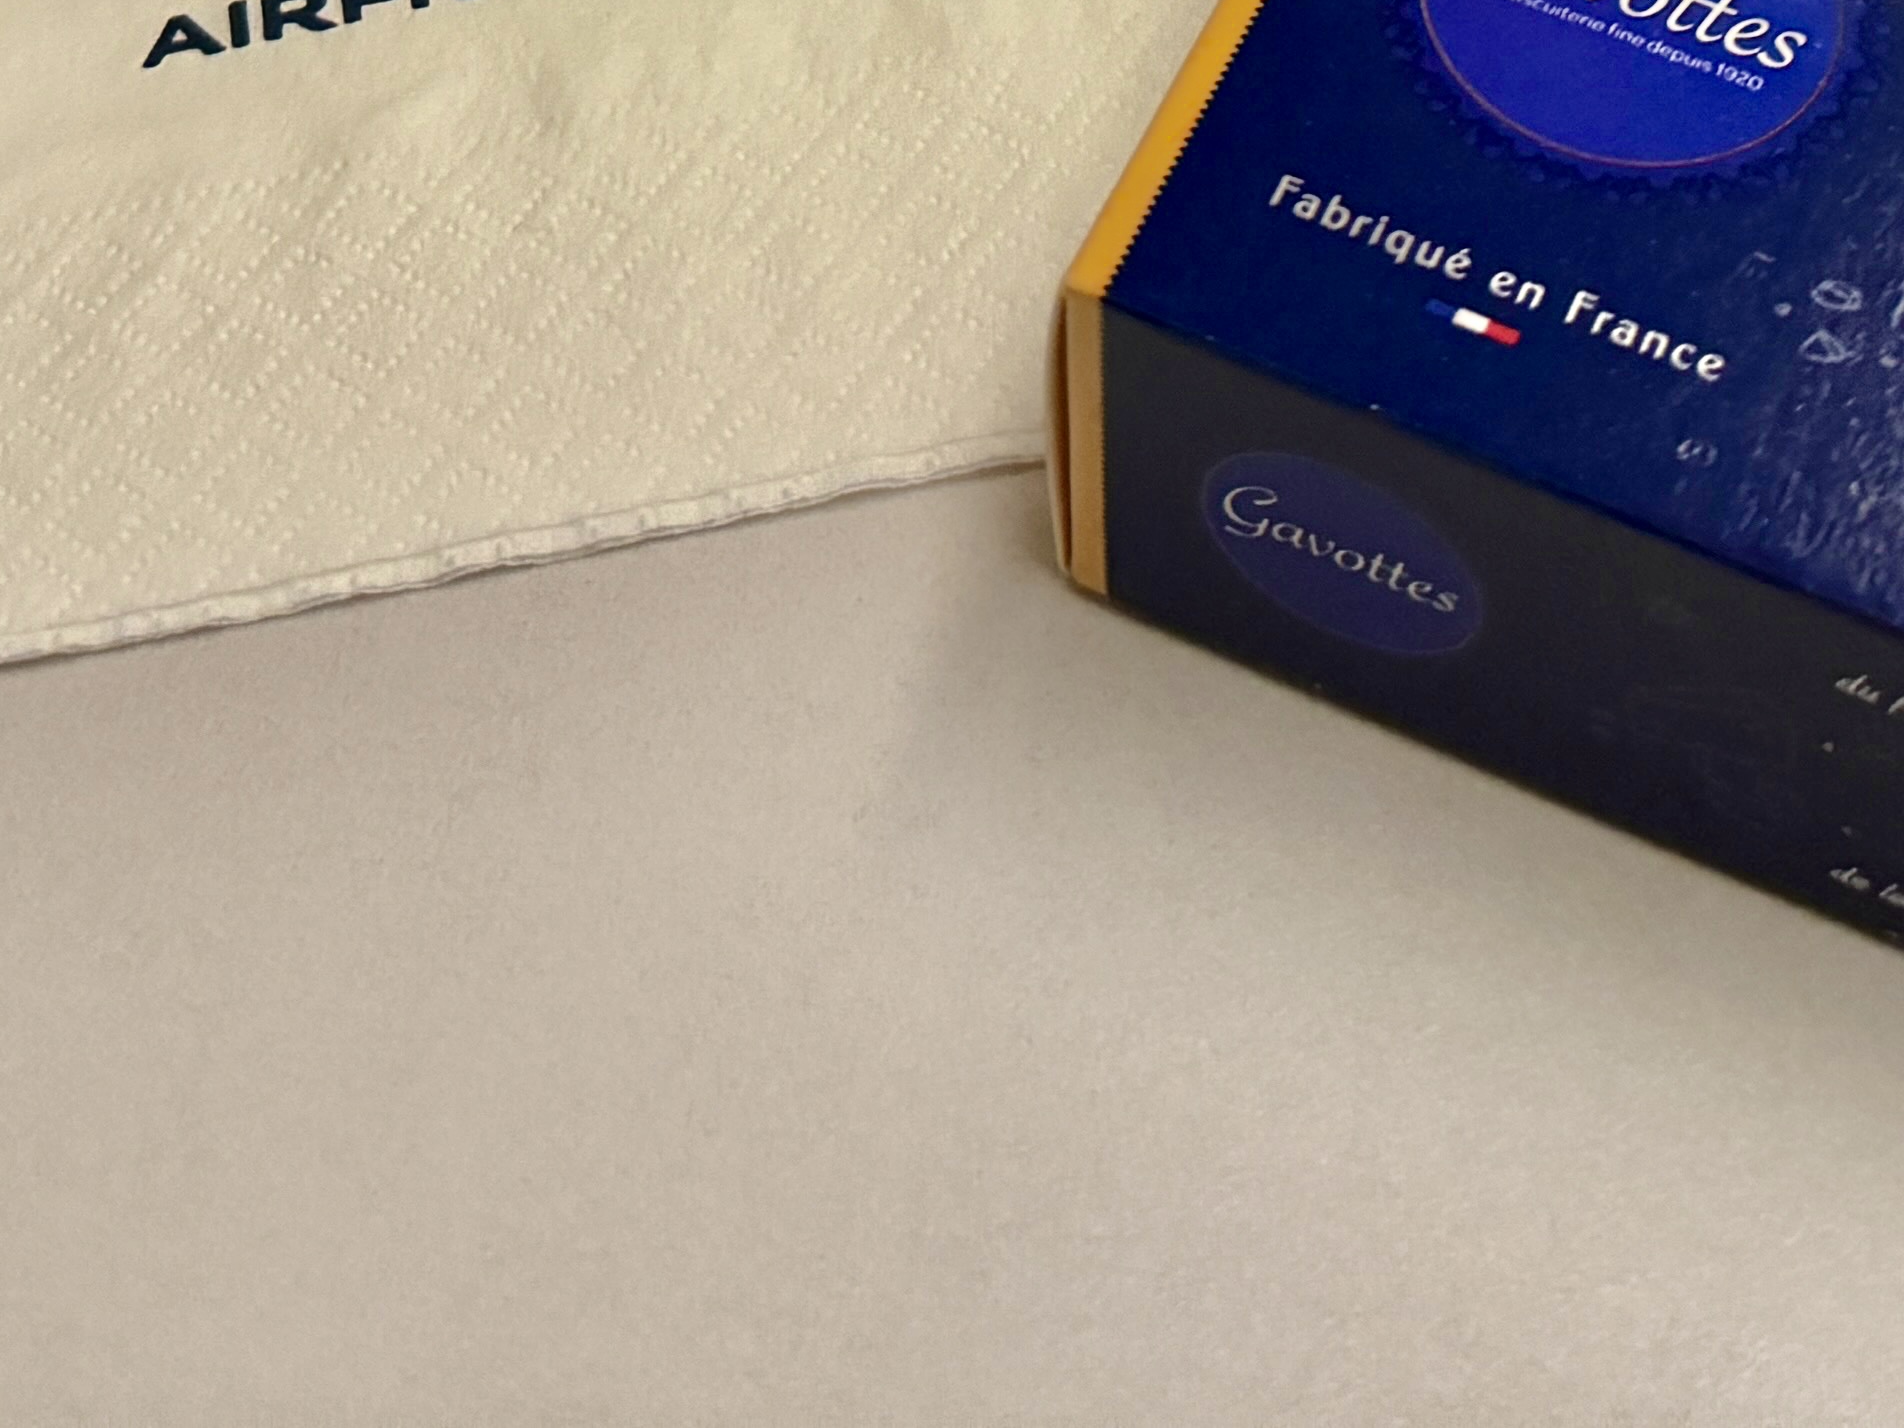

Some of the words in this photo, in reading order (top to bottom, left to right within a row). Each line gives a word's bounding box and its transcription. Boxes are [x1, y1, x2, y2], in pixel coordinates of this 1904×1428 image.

[1606, 22, 1646, 49] fine
[1646, 39, 1713, 75] depuis
[1715, 61, 1766, 92] 1920
[1268, 172, 1474, 281] Fabriqué
[1487, 268, 1547, 312] en
[1562, 289, 1728, 383] France
[1222, 484, 1460, 613] Gavottes
[1834, 673, 1880, 705] du
[1828, 866, 1871, 891] de
